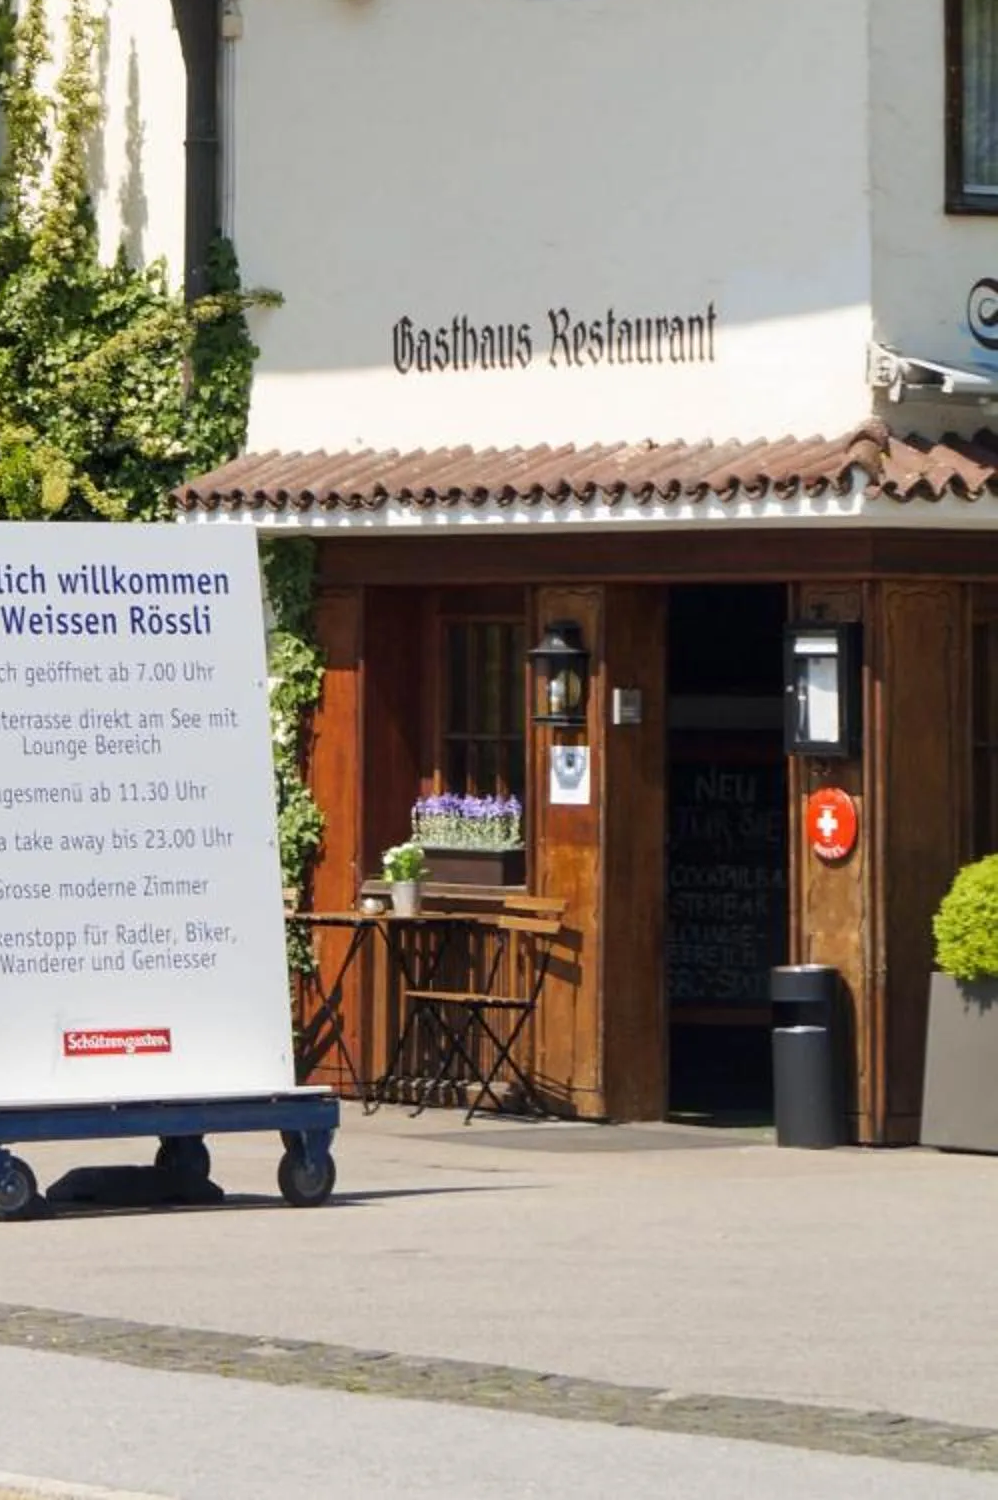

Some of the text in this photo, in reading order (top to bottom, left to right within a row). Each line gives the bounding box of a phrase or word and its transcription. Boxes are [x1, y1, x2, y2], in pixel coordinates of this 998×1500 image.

[393, 301, 716, 375] Gasthaus Restaurant
[58, 564, 229, 595] willkommen
[0, 606, 117, 636] Weissen
[130, 604, 212, 635] Rössli
[25, 662, 102, 688] geöffnet
[108, 662, 129, 682] ab
[136, 662, 176, 682] 7.00
[183, 662, 216, 681] Uhr
[79, 710, 131, 730] direkt
[138, 711, 165, 729] am
[171, 709, 201, 729] See
[208, 708, 239, 727] mit
[22, 734, 161, 760] Lounge Bereich
[90, 782, 111, 802] ab
[119, 782, 169, 801] 11.30
[176, 782, 208, 800] Uhr
[14, 831, 53, 851] take
[60, 835, 105, 855] away
[113, 831, 137, 850] bis
[144, 829, 195, 849] 23.00
[202, 828, 234, 848] Uhr
[59, 877, 137, 898] moderne
[143, 876, 208, 897] Zimmer
[83, 925, 108, 945] für
[116, 924, 177, 948] Radler,
[186, 922, 237, 943] Biker,
[0, 950, 218, 974] Wanderer und Geniesser
